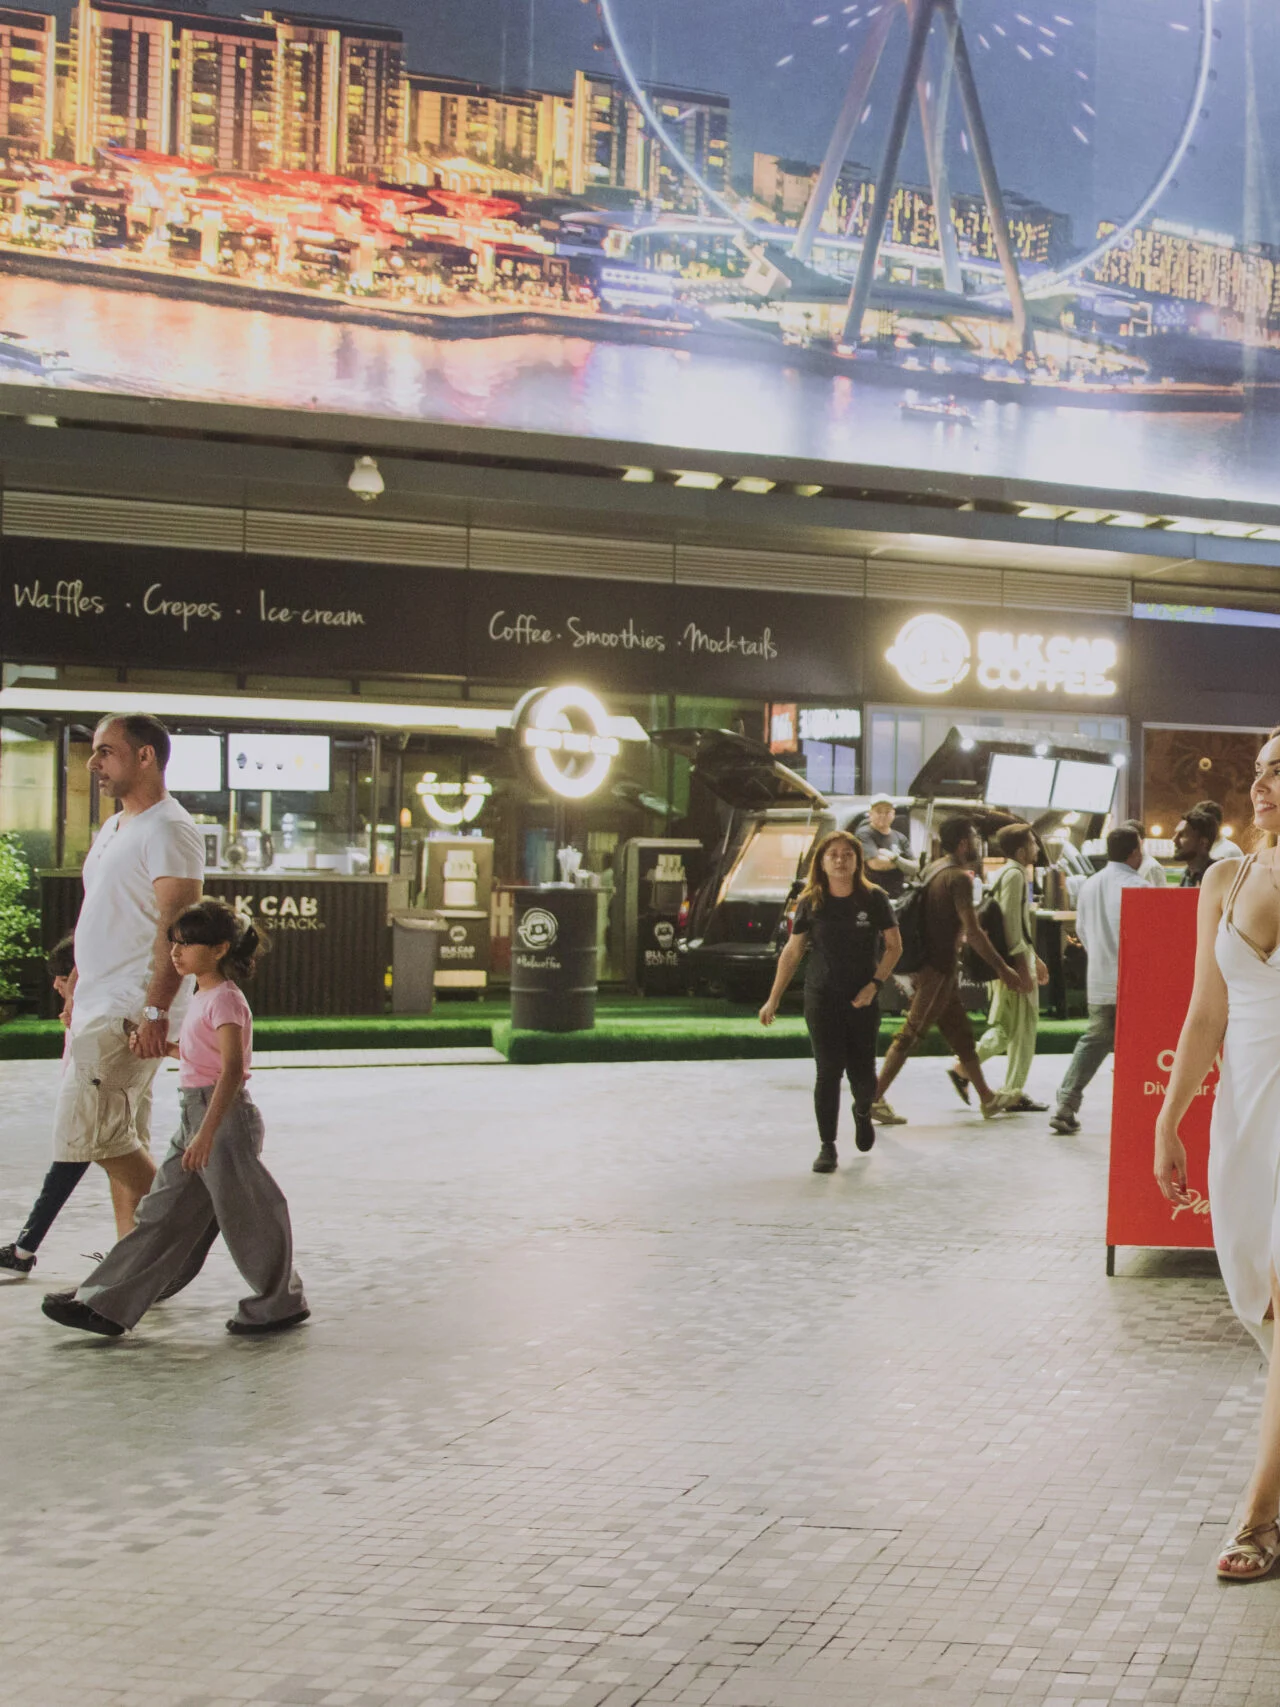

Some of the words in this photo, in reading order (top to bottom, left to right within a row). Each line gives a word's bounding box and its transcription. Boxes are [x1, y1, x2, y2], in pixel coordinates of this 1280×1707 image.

[14, 580, 104, 617] Waffles
[143, 583, 222, 632] Crepes
[489, 611, 552, 645] Coffee
[567, 616, 665, 652] Smoothies
[684, 622, 778, 660] Mocktails
[260, 896, 318, 916] CAB
[265, 917, 318, 930] SHACK
[1143, 1081, 1167, 1096] Div
